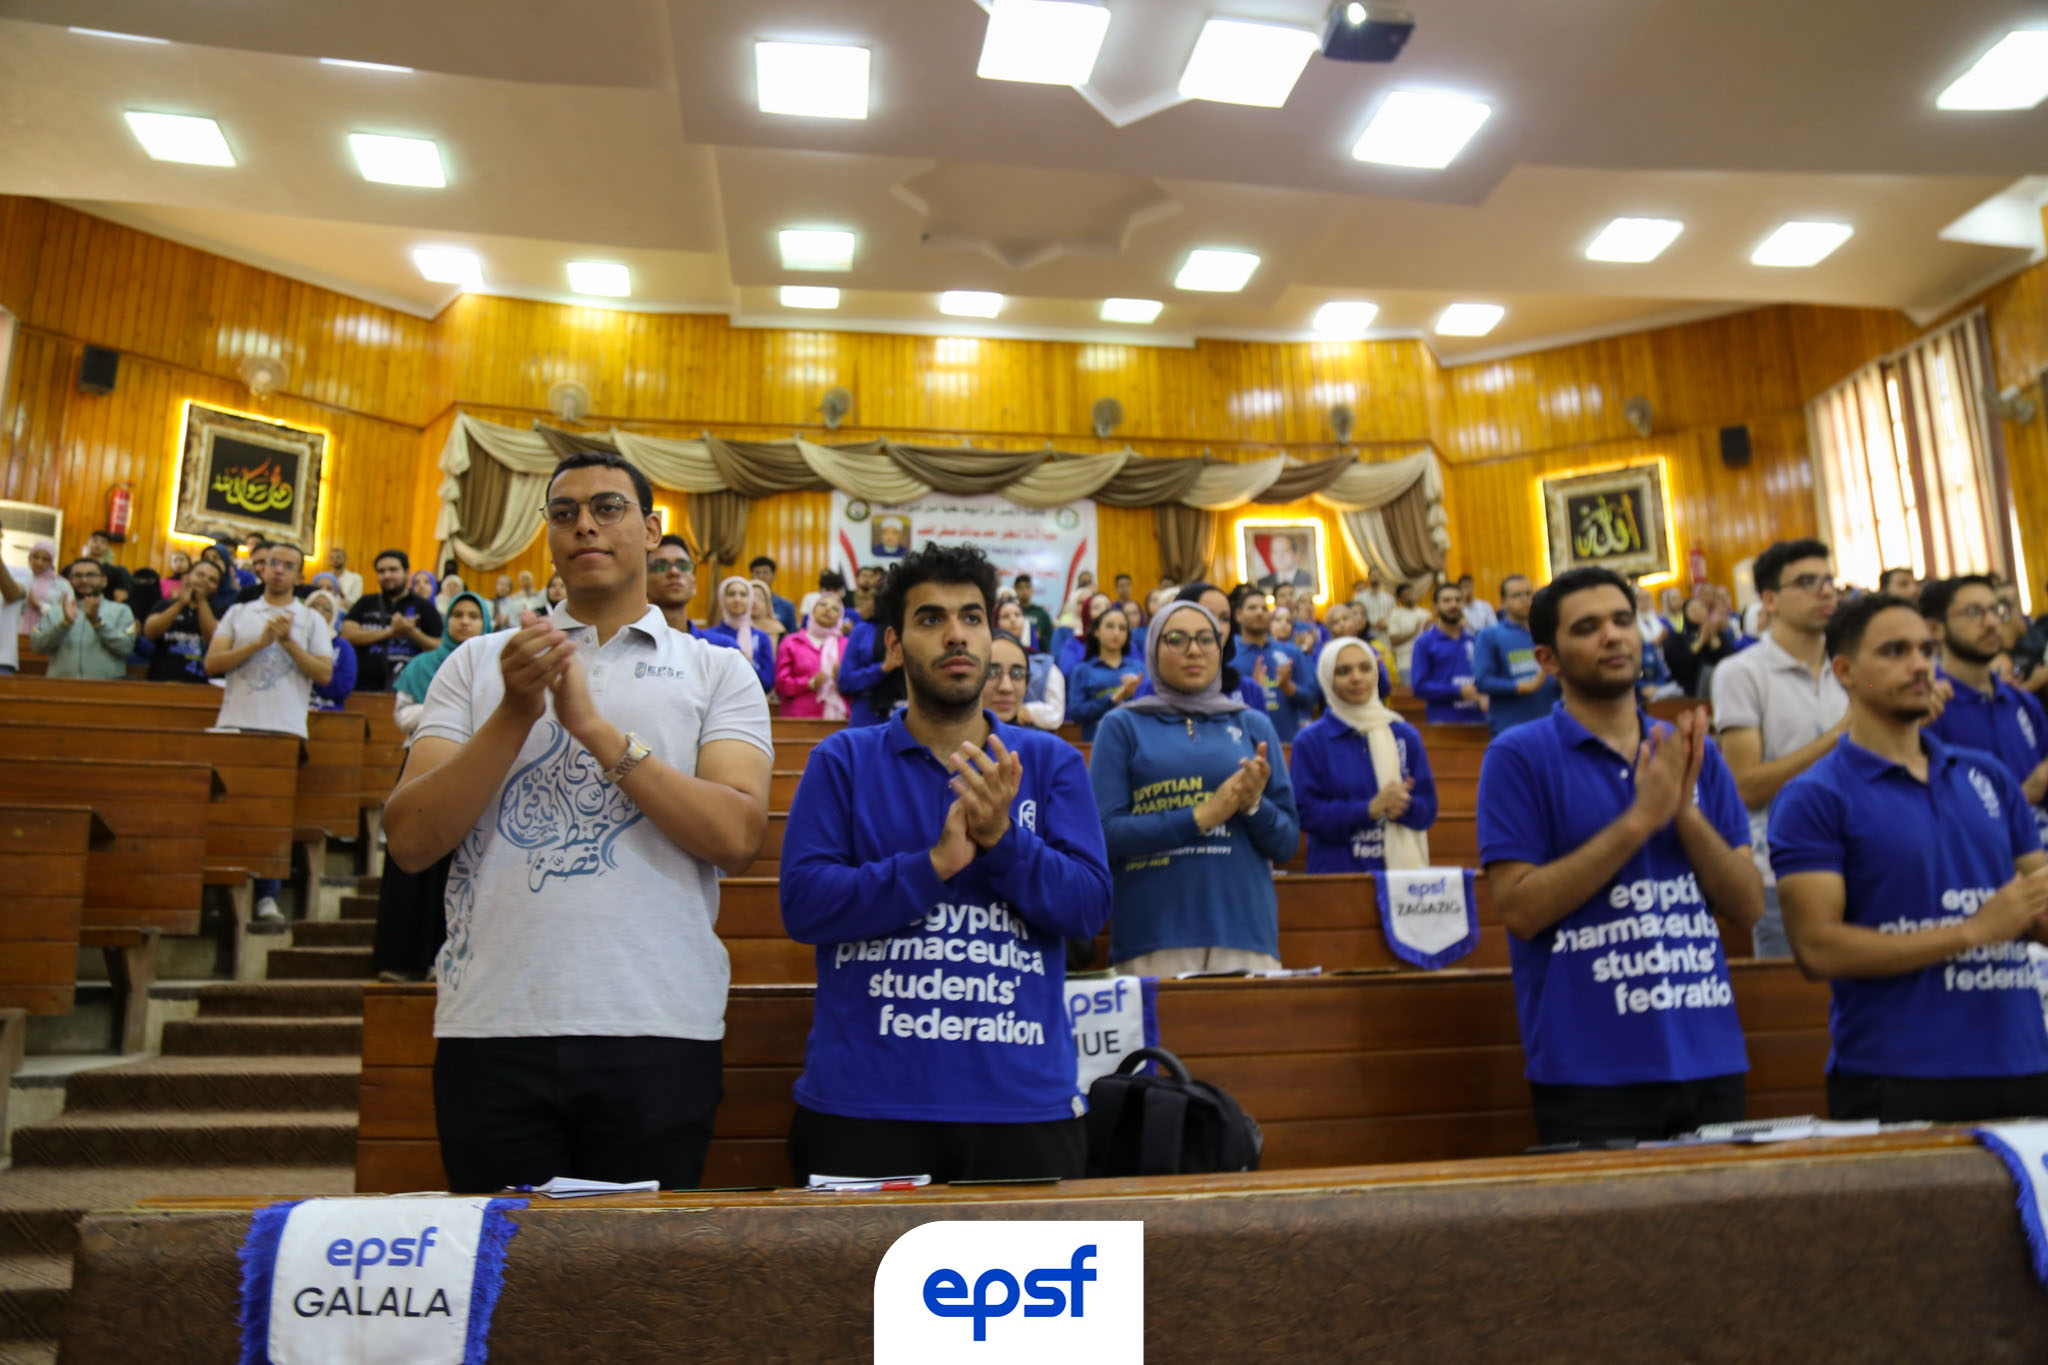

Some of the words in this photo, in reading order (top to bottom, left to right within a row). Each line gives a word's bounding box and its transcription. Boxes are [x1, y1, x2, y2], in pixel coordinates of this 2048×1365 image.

[868, 967, 1021, 1006] students'
[1069, 979, 1128, 1028] psf
[879, 1003, 1046, 1046] federation
[326, 1226, 438, 1280] epsf
[293, 1286, 453, 1318] GALALA
